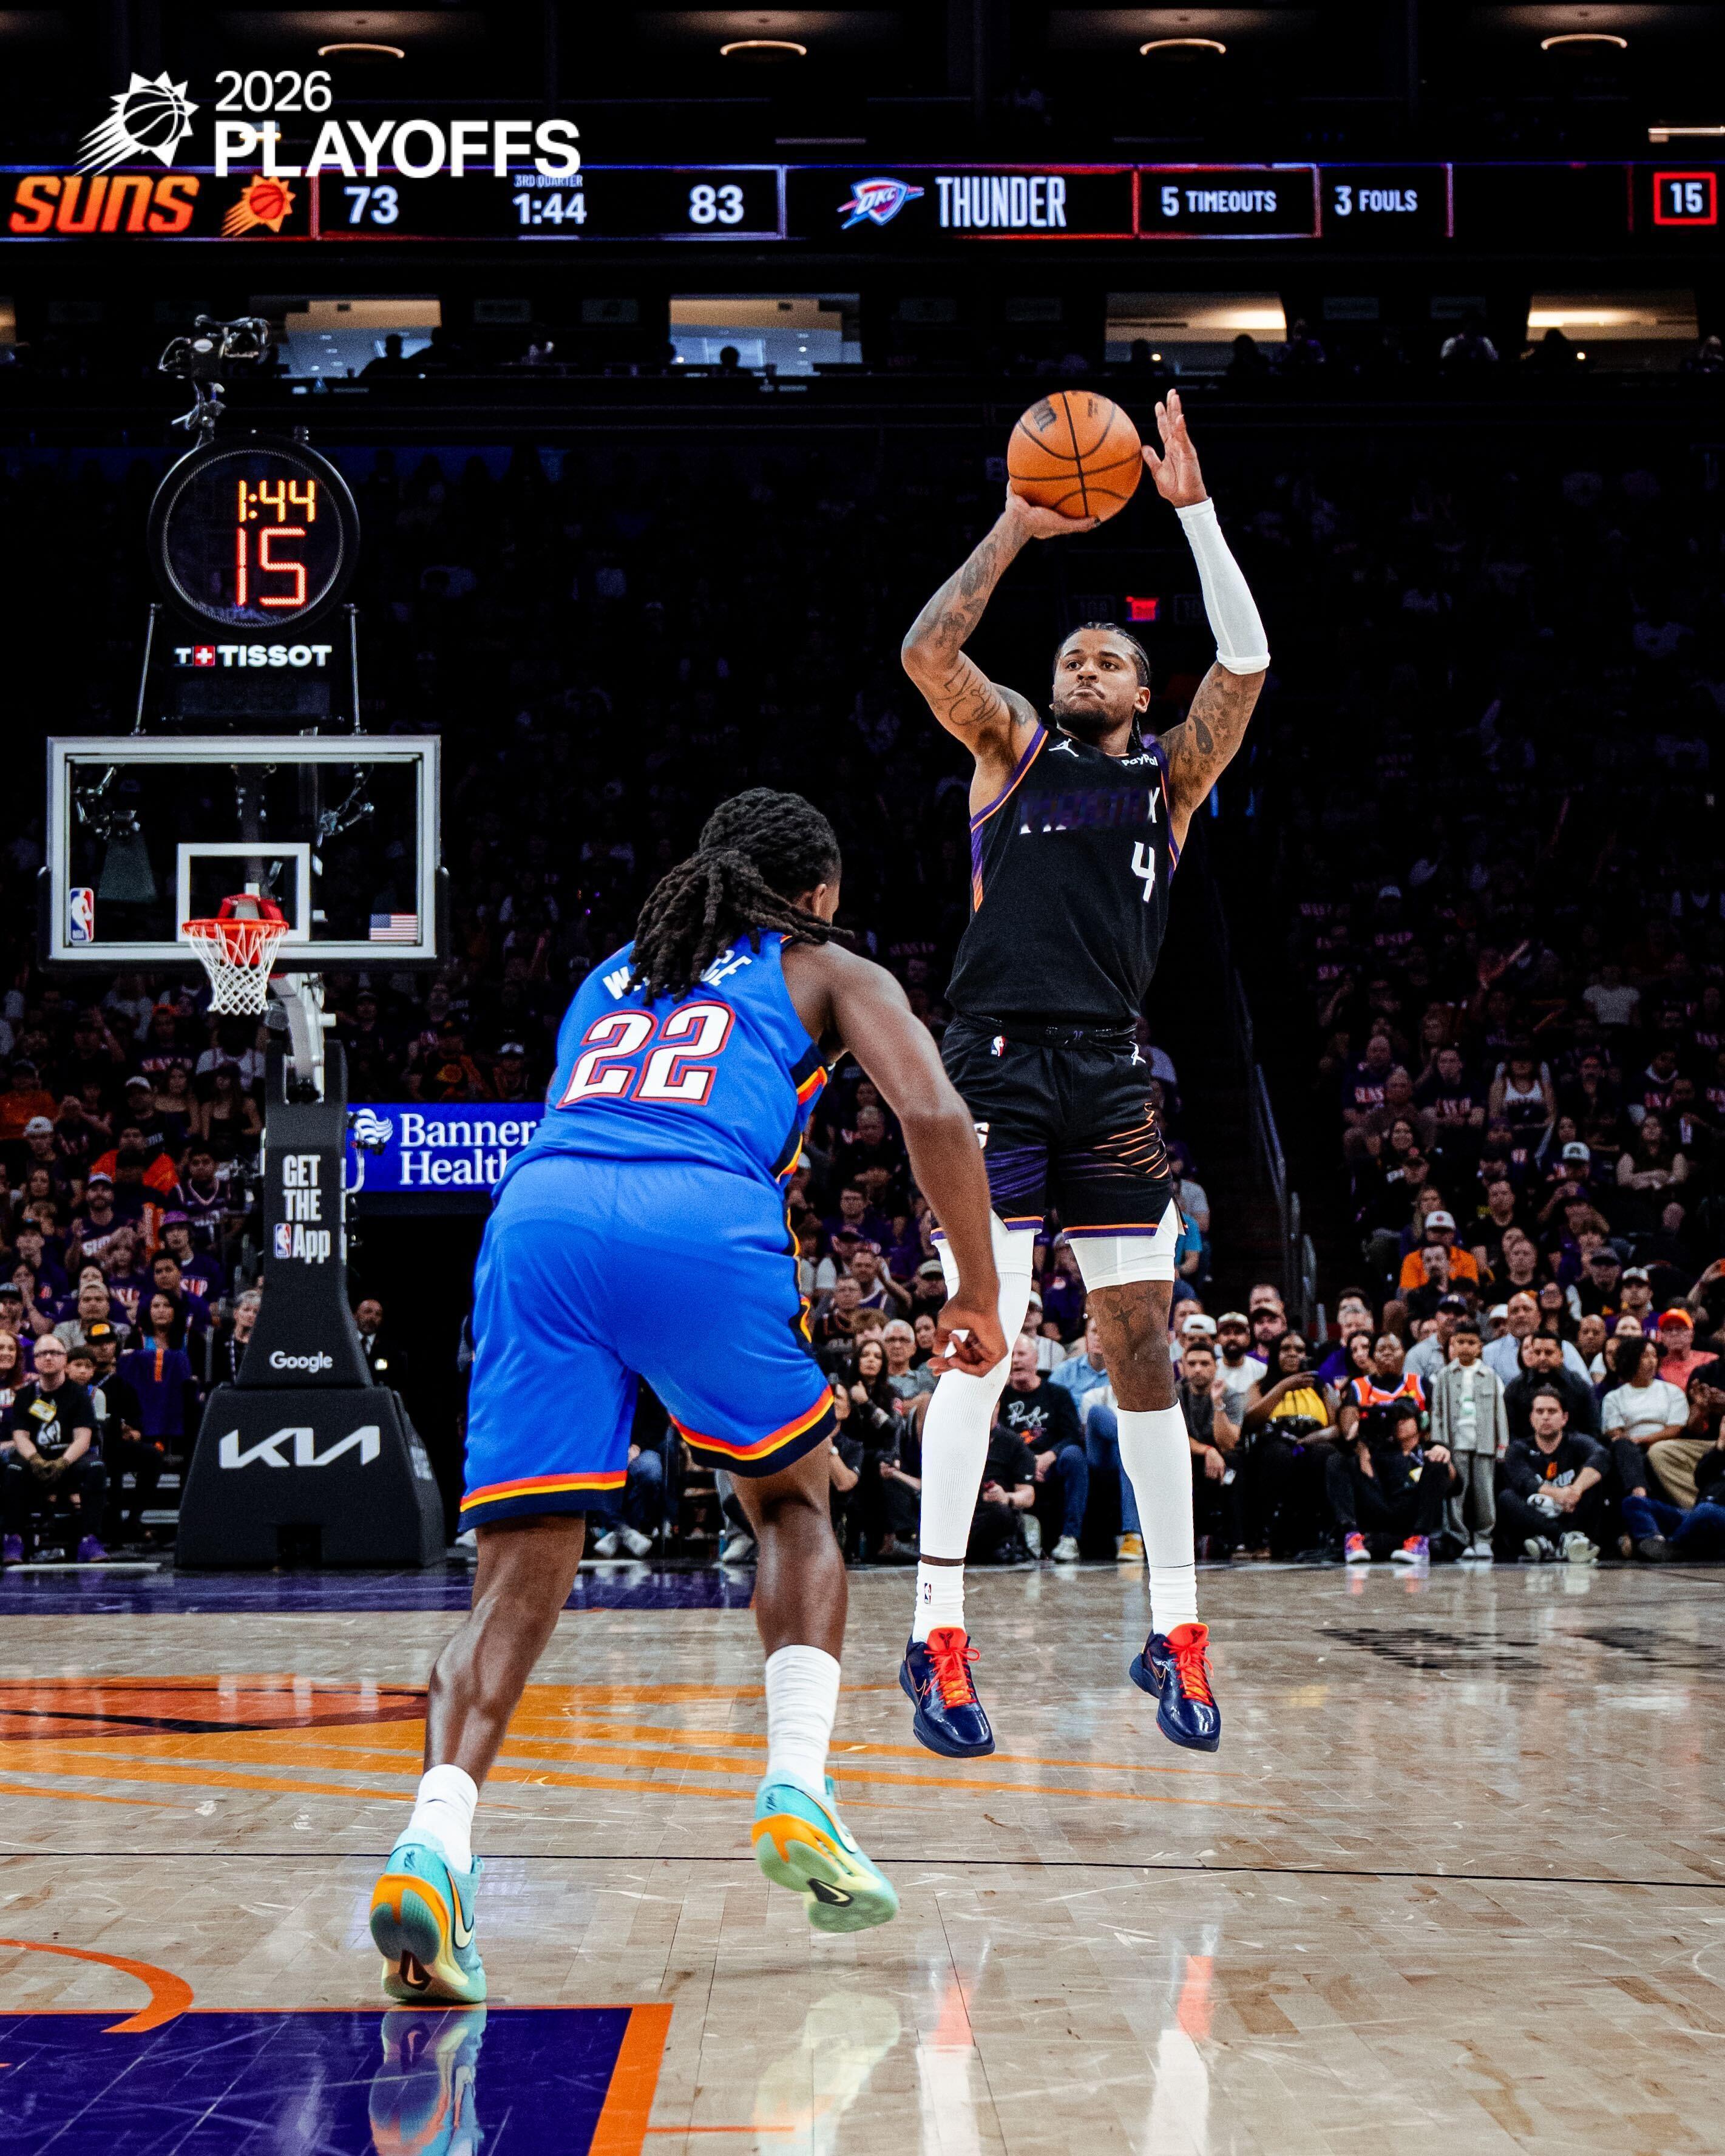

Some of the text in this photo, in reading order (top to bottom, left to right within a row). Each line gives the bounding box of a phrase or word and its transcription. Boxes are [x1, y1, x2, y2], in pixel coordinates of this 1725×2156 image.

[514, 174, 583, 188] 3RD QUARTER
[1671, 183, 1703, 212] 15
[10, 175, 199, 232] SUNS
[344, 185, 398, 224] 73
[513, 193, 587, 224] 1:44
[689, 185, 744, 224] 83
[935, 176, 1066, 228] THUNDER
[1162, 186, 1276, 216] 5 TIMEOUTS
[1335, 186, 1417, 215] 3 FOULS
[239, 480, 315, 522] 1:44
[237, 527, 306, 606] 15
[217, 645, 332, 666] TISSOT
[1122, 754, 1158, 766] PayPal
[1131, 841, 1155, 903] 4
[556, 1000, 736, 1109] 22
[399, 1113, 537, 1147] Banner
[283, 1155, 320, 1187] GET
[282, 1189, 321, 1221] THE
[292, 1224, 330, 1264] App
[269, 1351, 333, 1373] Google
[219, 1426, 380, 1468] KIA
